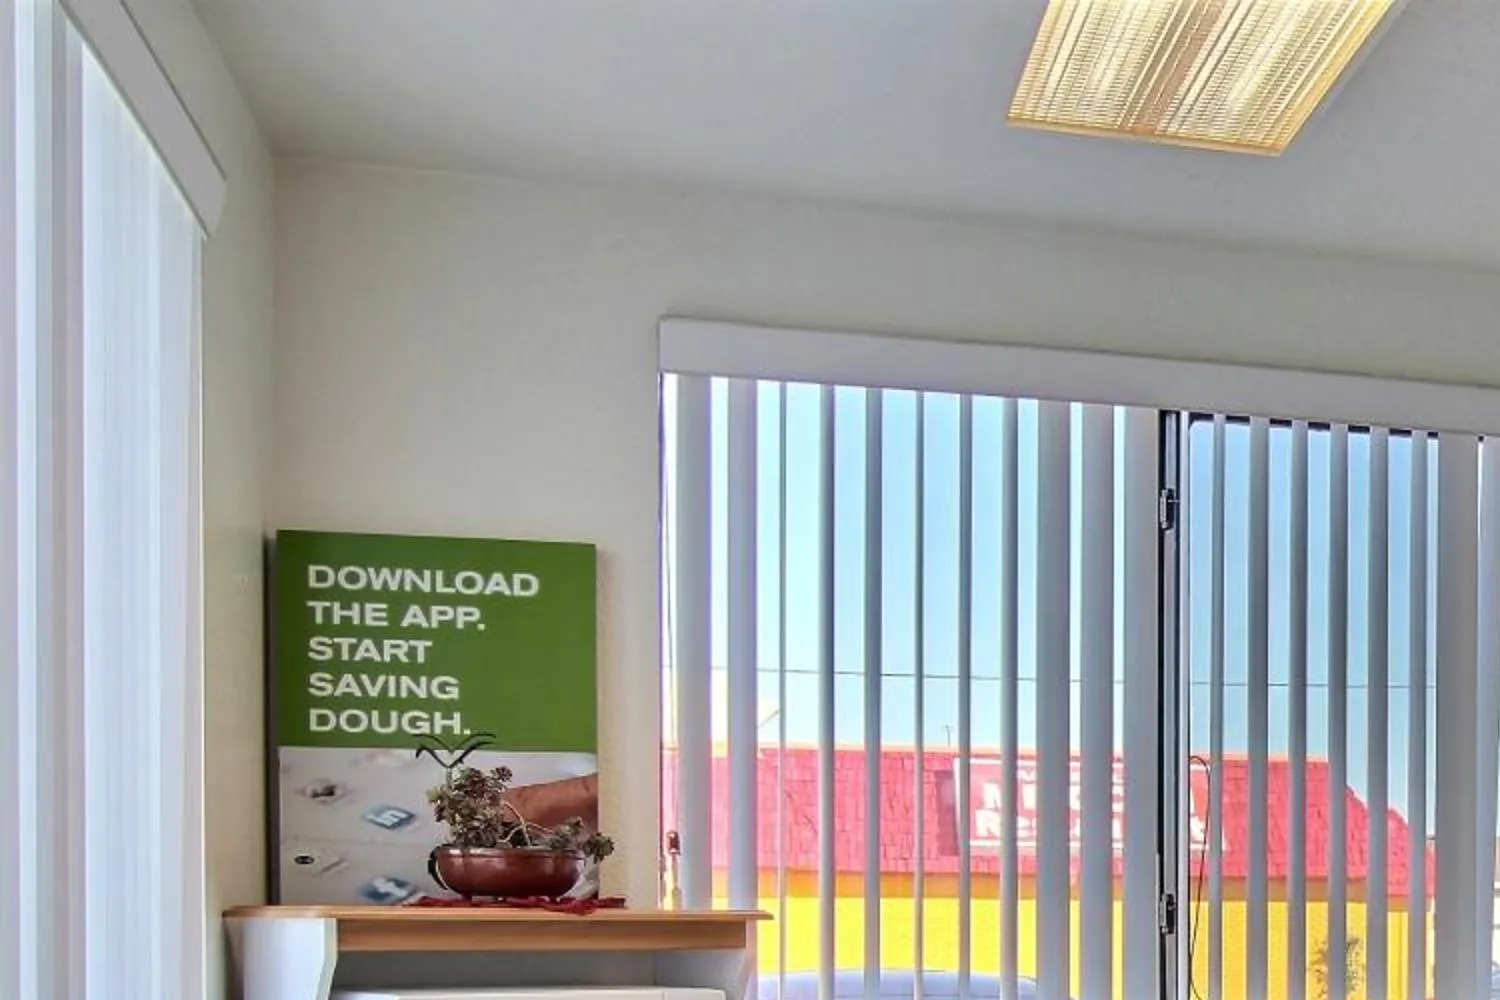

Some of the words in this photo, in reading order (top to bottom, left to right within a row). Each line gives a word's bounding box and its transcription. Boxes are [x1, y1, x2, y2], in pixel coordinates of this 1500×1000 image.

[308, 565, 539, 597] DOWNLOAD
[307, 601, 389, 627] THE
[399, 604, 485, 631] APP.
[308, 636, 433, 664] START
[309, 672, 460, 700] SAVING
[309, 708, 471, 735] DOUGH.
